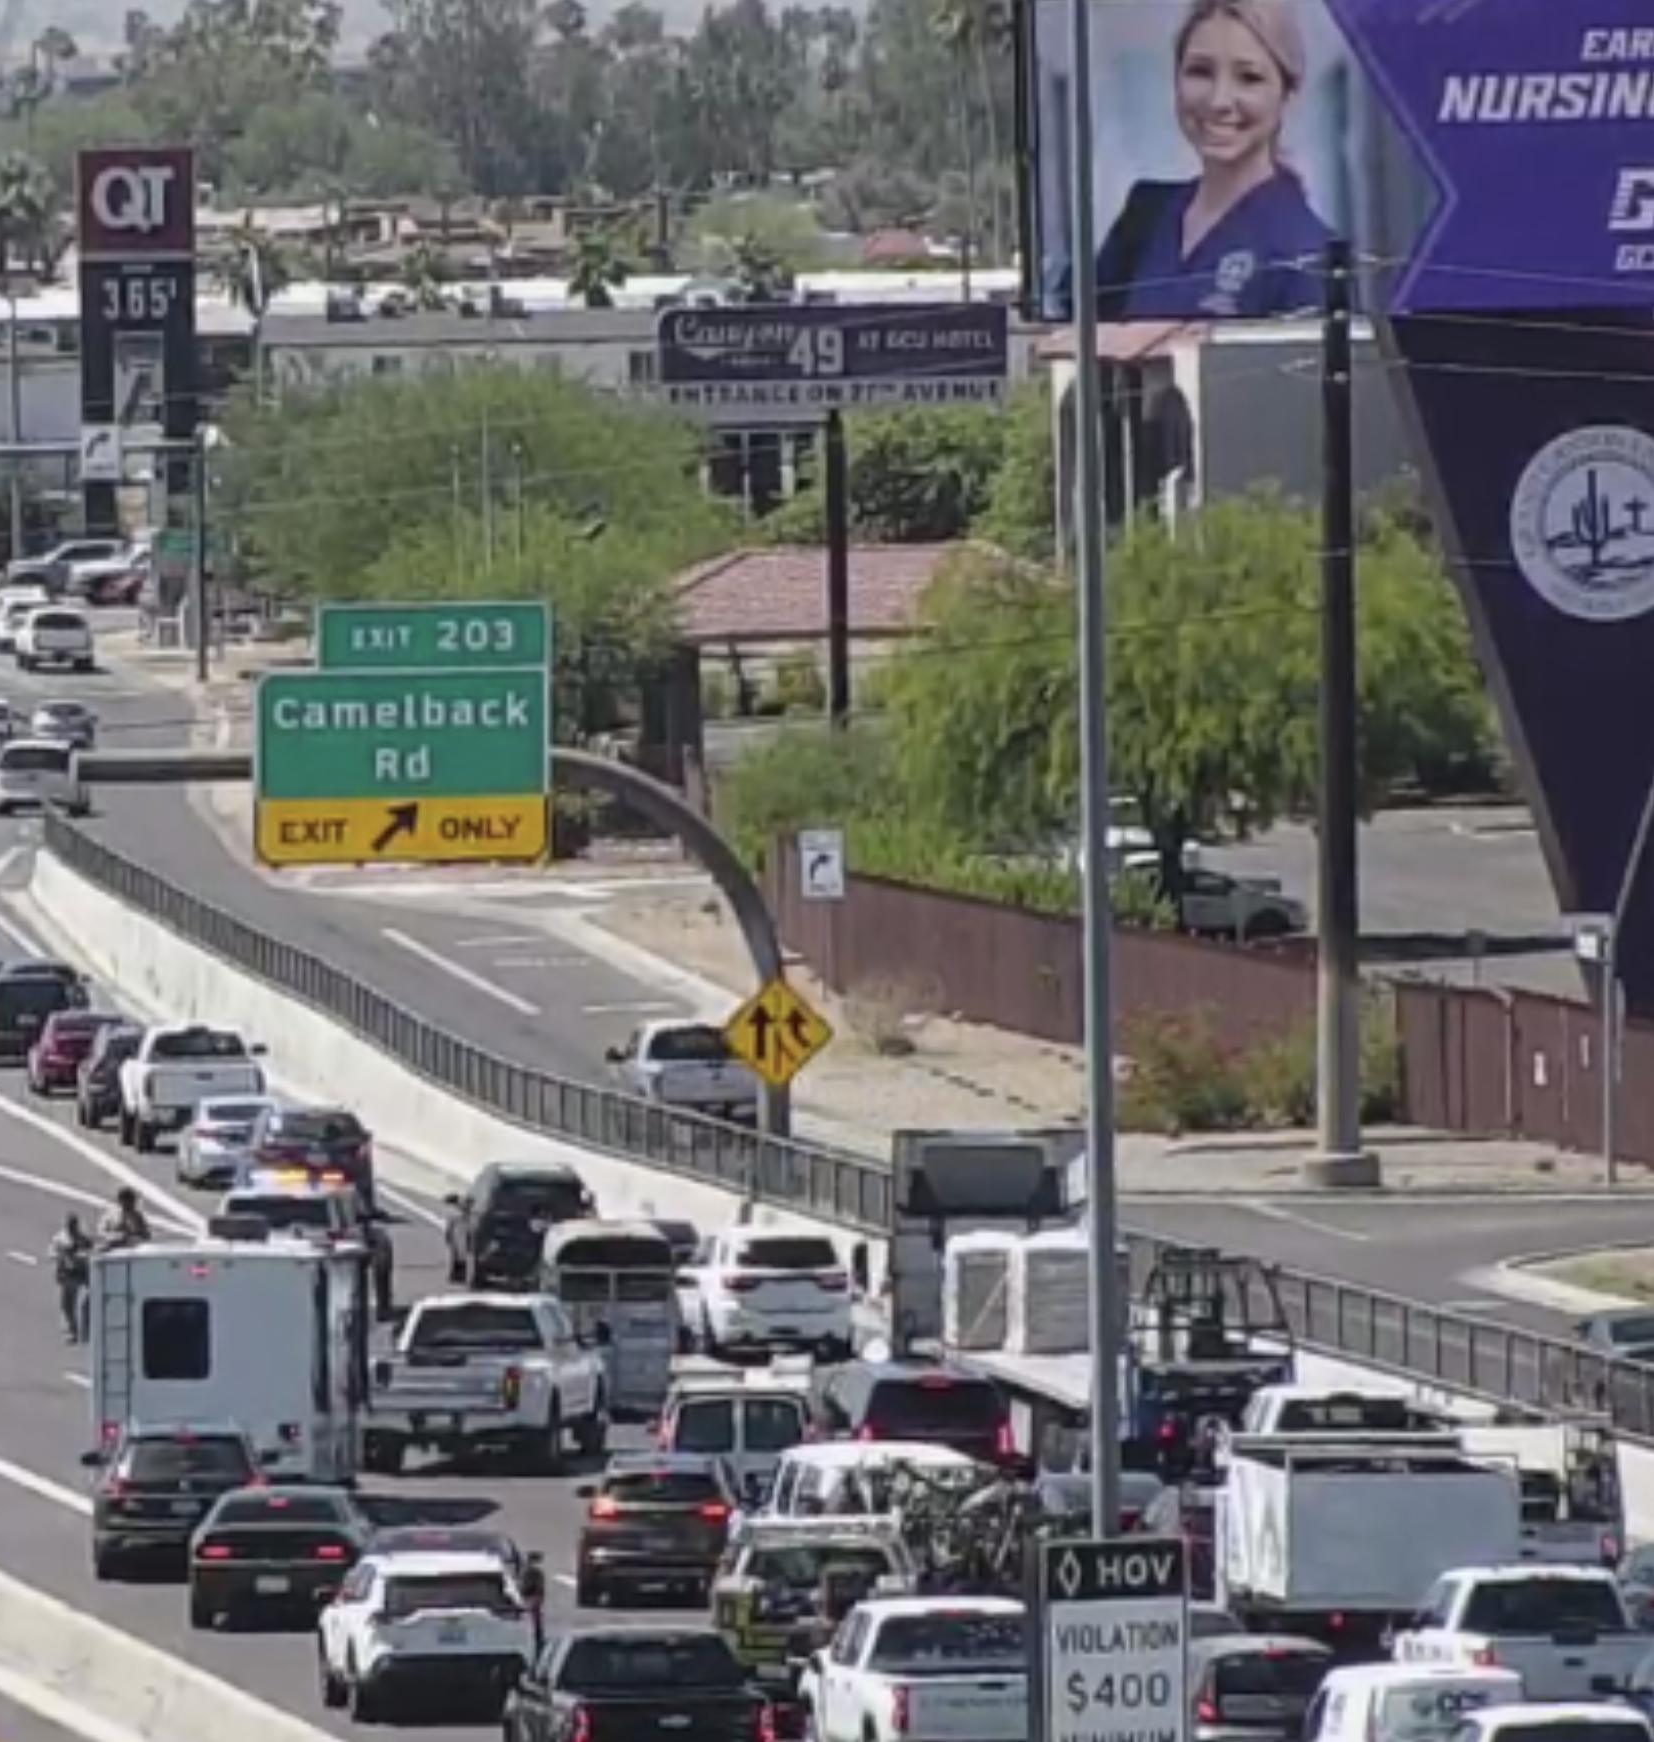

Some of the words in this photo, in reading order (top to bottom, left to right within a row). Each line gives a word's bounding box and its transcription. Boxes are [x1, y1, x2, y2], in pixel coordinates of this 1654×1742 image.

[1438, 71, 1654, 121] NURSIN
[92, 166, 175, 233] QT
[788, 327, 843, 376] 49
[351, 625, 413, 649] EXIT
[437, 620, 515, 650] 203
[273, 692, 529, 729] Camelback
[375, 744, 430, 781] Rd
[279, 818, 349, 845] EXIT
[438, 814, 522, 840] ONLY
[1097, 1553, 1174, 1587] HOV
[1057, 1620, 1179, 1654] VIOLATION
[1067, 1670, 1171, 1716] $400
